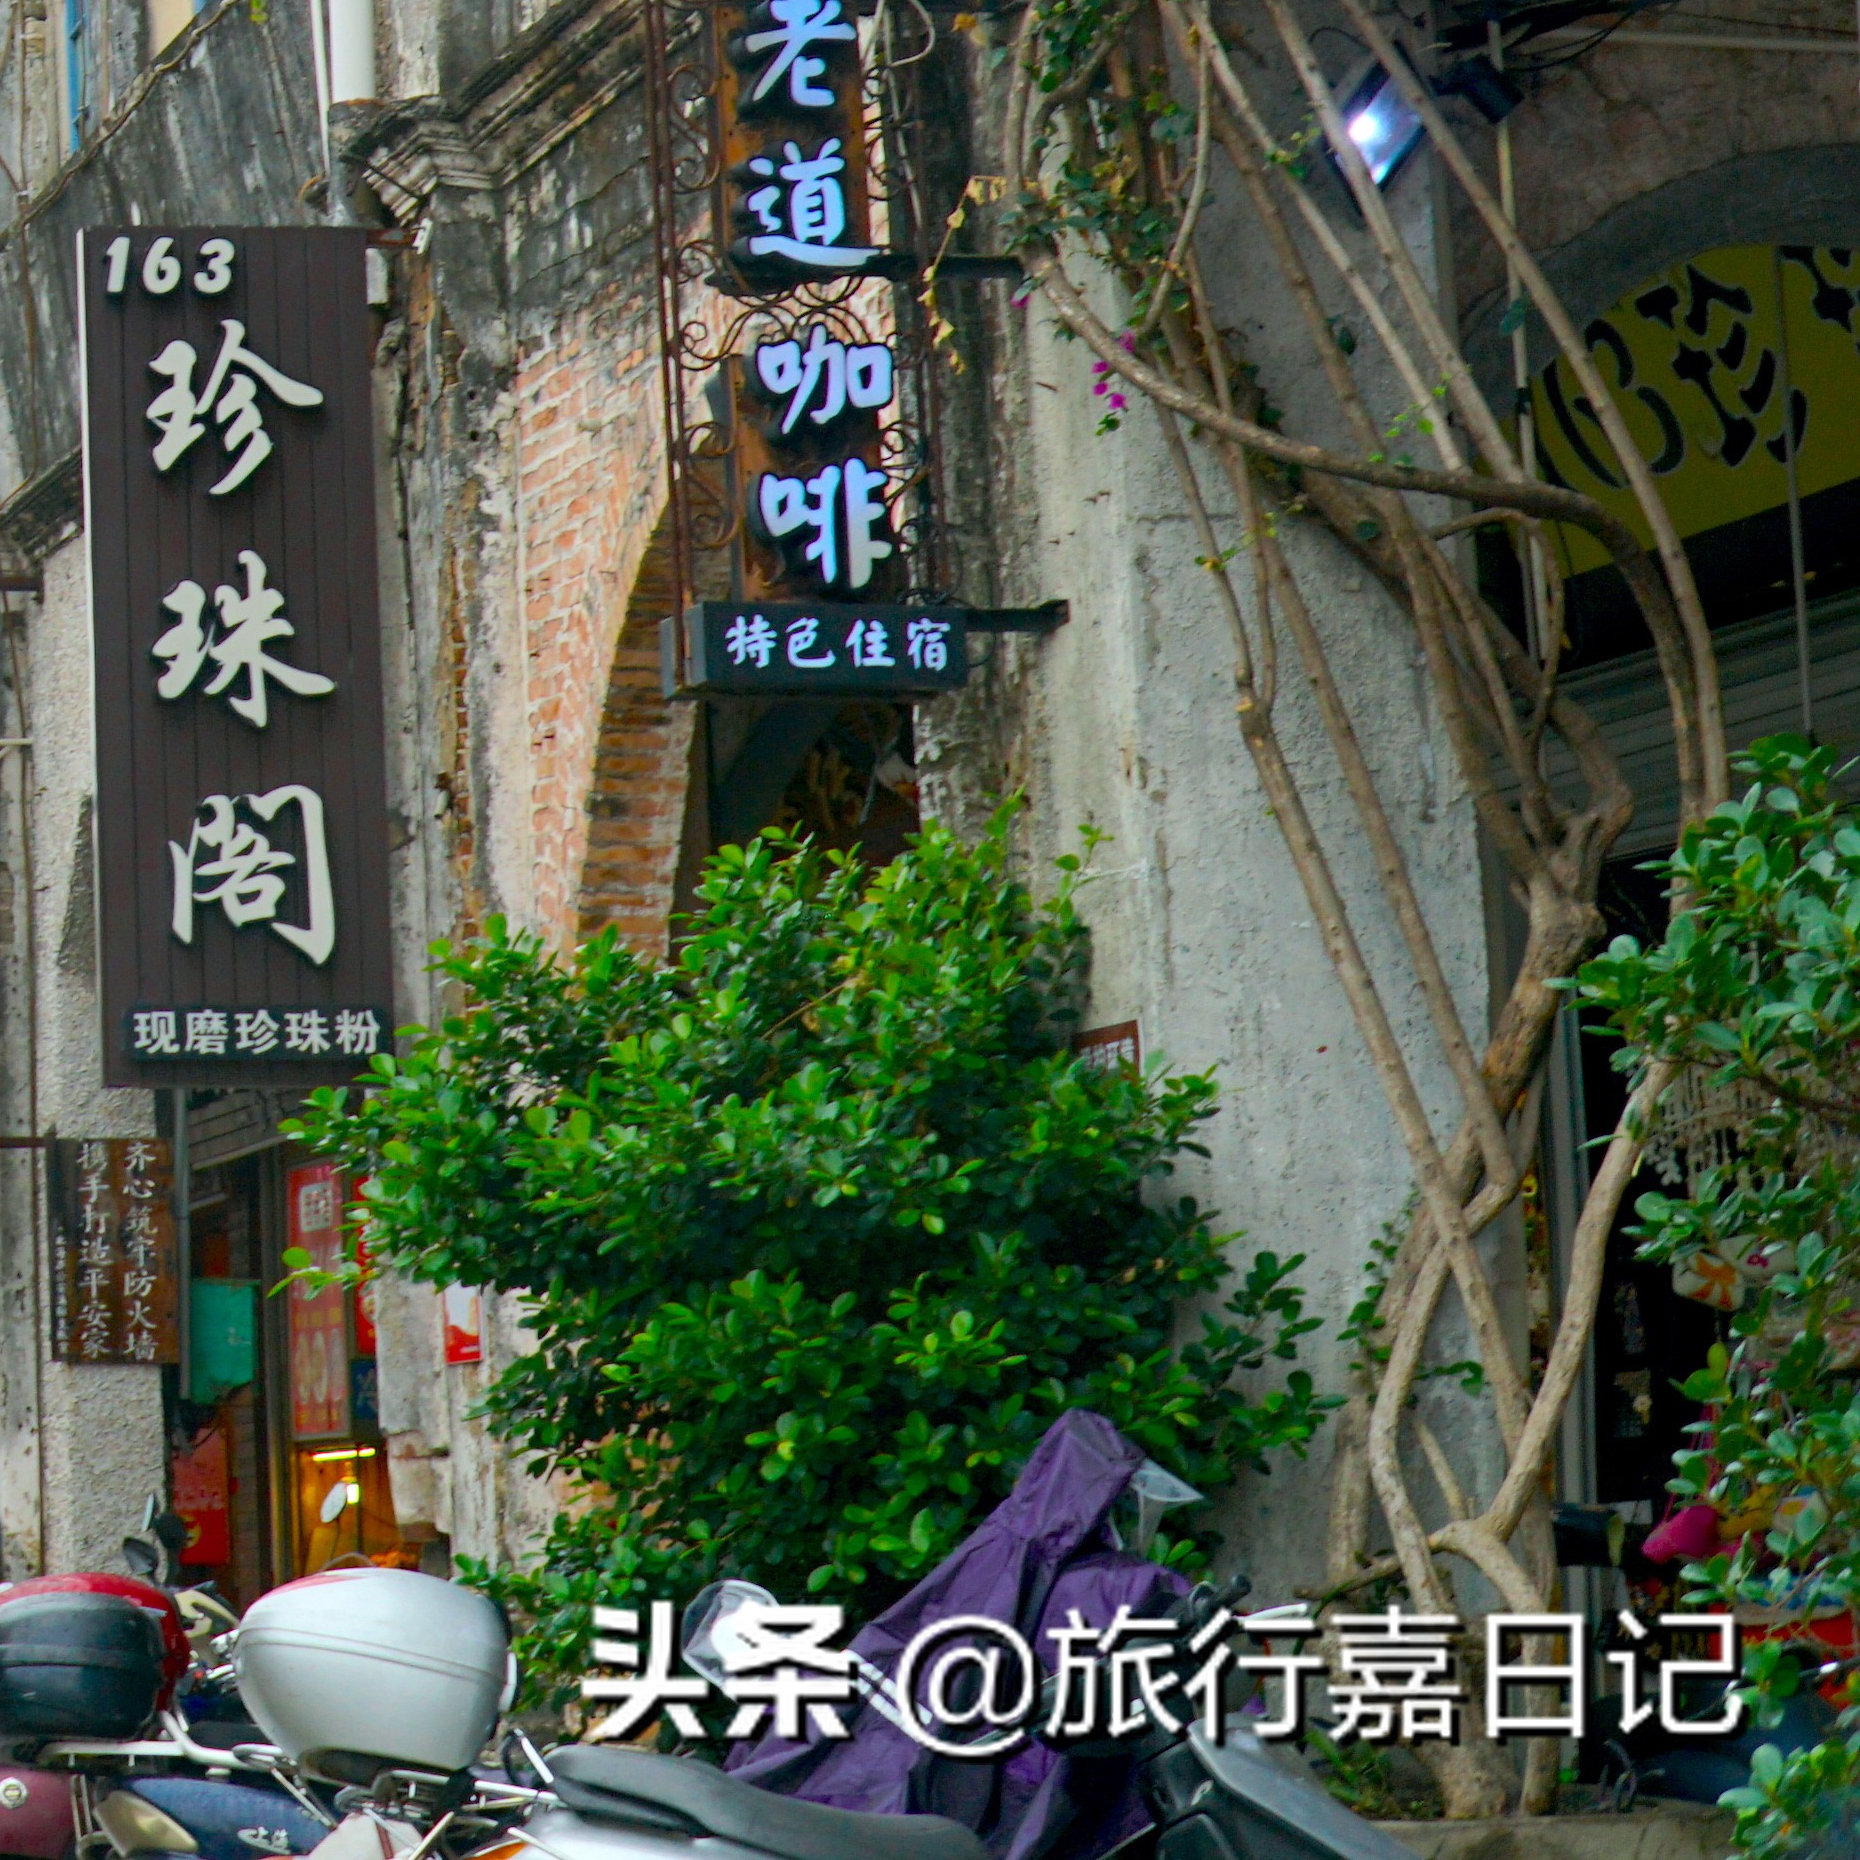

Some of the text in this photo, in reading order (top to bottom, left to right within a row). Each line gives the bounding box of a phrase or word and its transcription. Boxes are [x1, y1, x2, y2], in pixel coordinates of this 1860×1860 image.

[106, 236, 236, 295] 163
[754, 325, 893, 590] 咖啡
[146, 320, 338, 965] 珍珠阁
[725, 617, 954, 673] 特色住宿
[134, 1010, 381, 1056] 现磨珍珠粉
[76, 1141, 114, 1358] 携手打造平安家
[122, 1142, 158, 1360] 齐心筑牢防火墙
